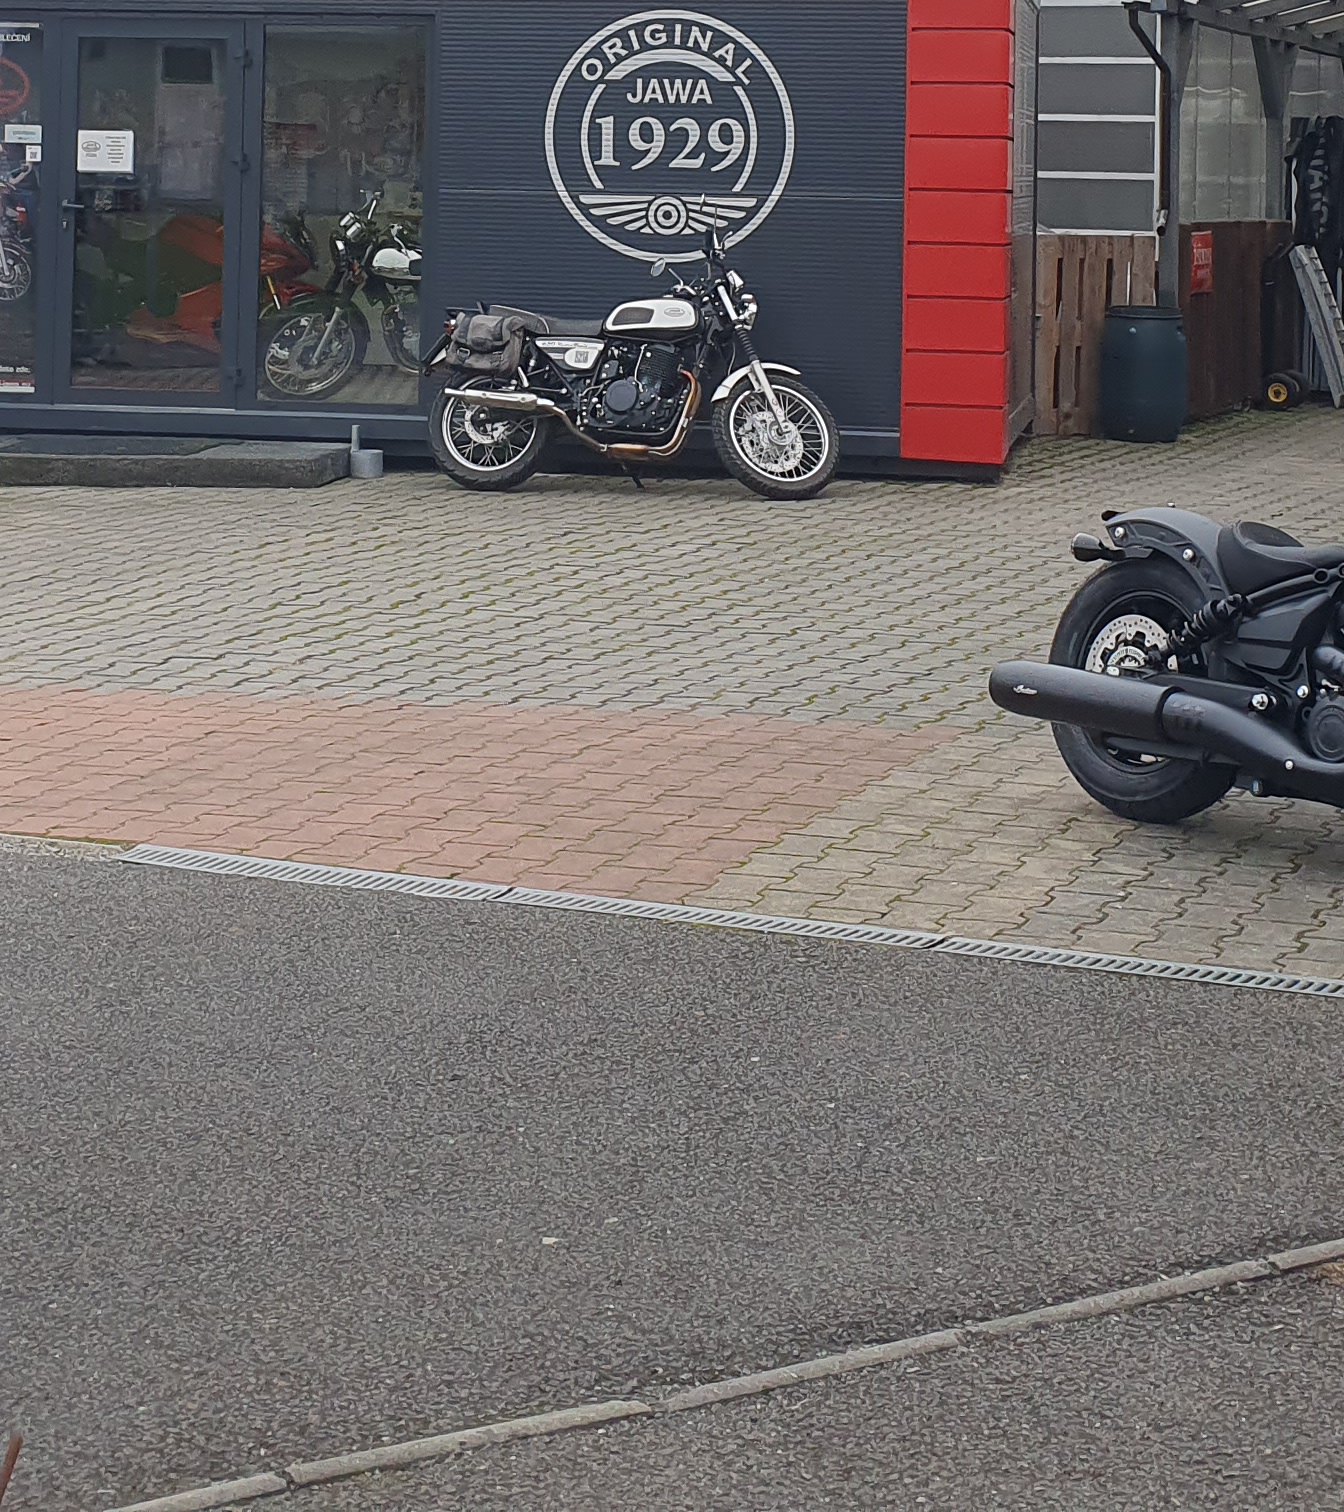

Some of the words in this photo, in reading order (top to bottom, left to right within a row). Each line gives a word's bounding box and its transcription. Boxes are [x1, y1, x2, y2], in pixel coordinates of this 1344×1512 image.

[581, 23, 754, 86] ORIGINAL
[626, 78, 713, 105] JAWA
[593, 115, 746, 172] 1929
